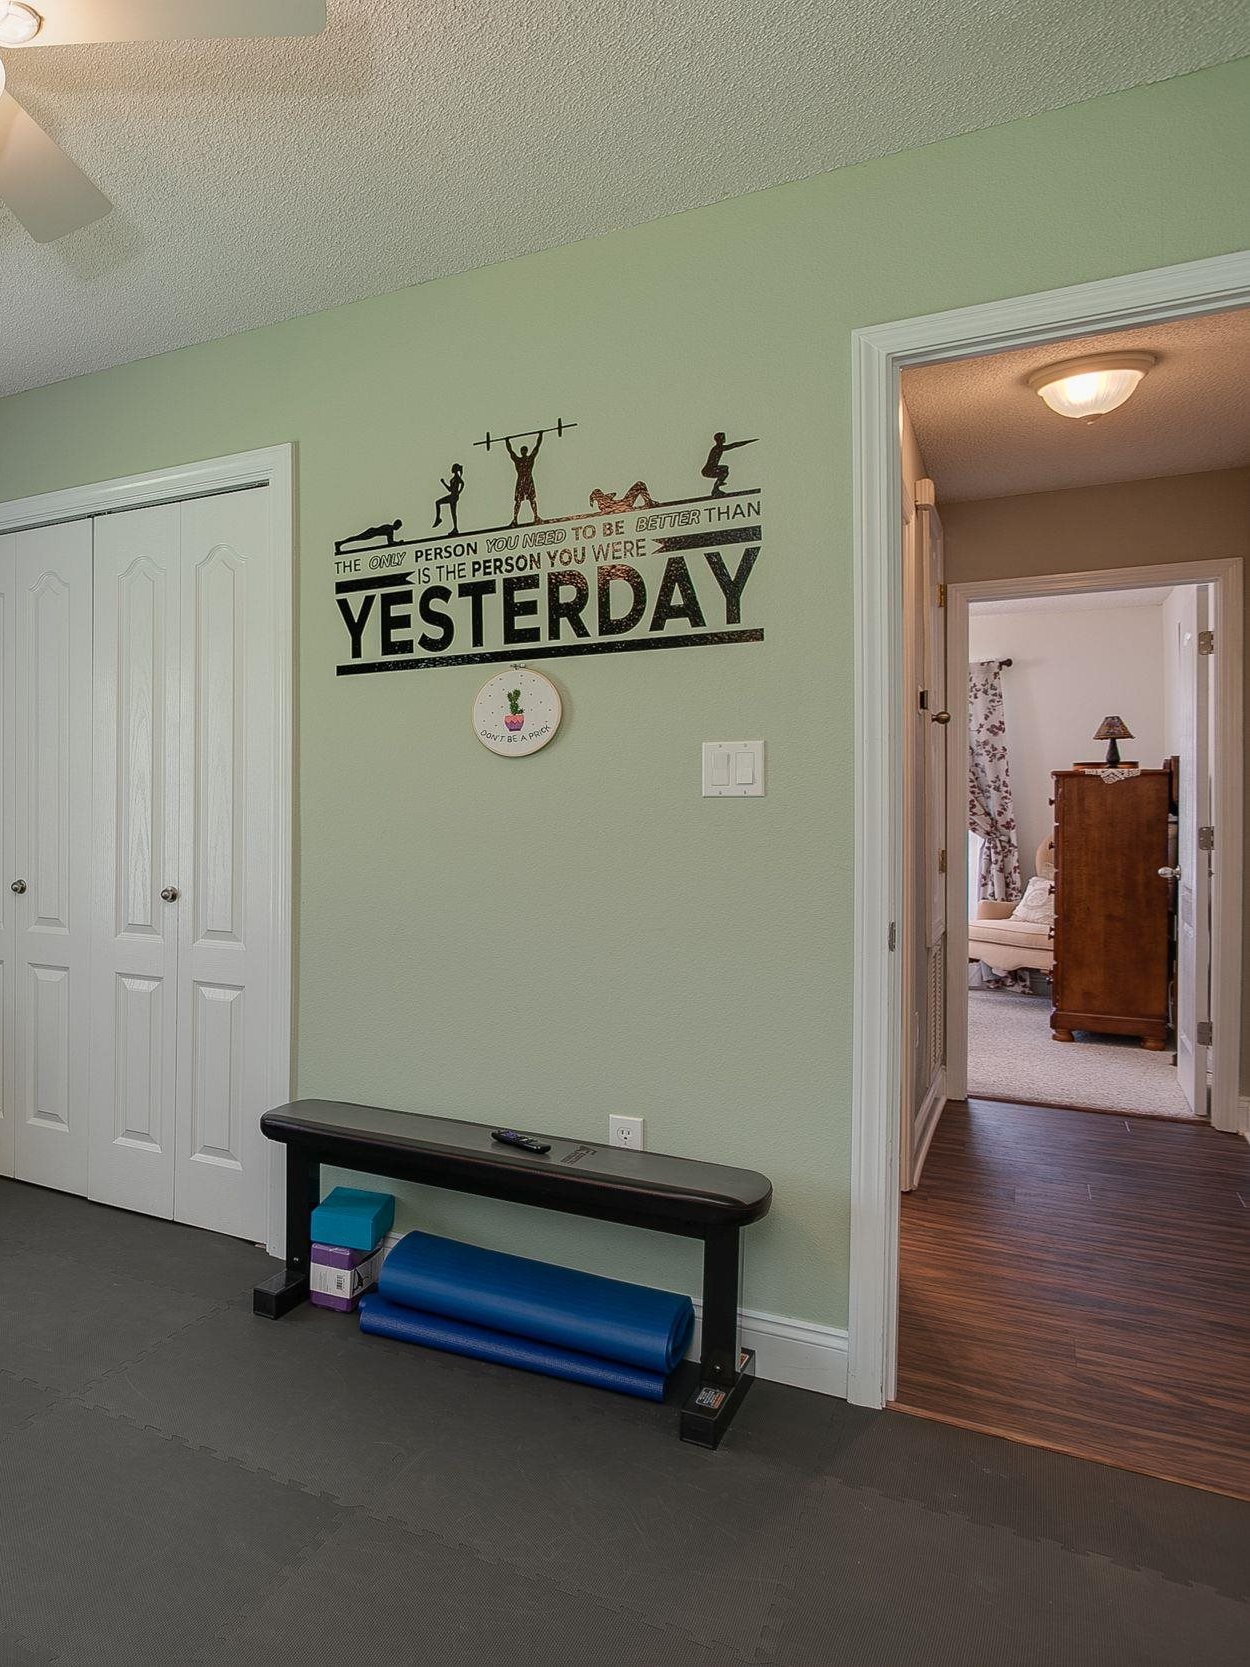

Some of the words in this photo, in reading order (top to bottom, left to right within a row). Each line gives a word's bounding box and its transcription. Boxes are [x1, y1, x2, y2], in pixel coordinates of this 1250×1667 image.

[334, 558, 362, 575] THE
[368, 551, 406, 570] ONLY
[414, 541, 478, 563] PERSON
[486, 534, 519, 553] YOU
[521, 528, 567, 550] NEED
[571, 523, 597, 541] TO
[602, 519, 625, 538] BE
[636, 508, 701, 533] BETTER
[704, 500, 761, 523] THAN
[417, 567, 431, 585] IS
[436, 562, 467, 582] THE
[471, 551, 541, 577] PERSON
[546, 546, 586, 568] YOU
[592, 537, 647, 562] WERE
[335, 546, 761, 660] YESTERDAY
[480, 729, 506, 743] DON'T
[507, 735, 518, 743] BE
